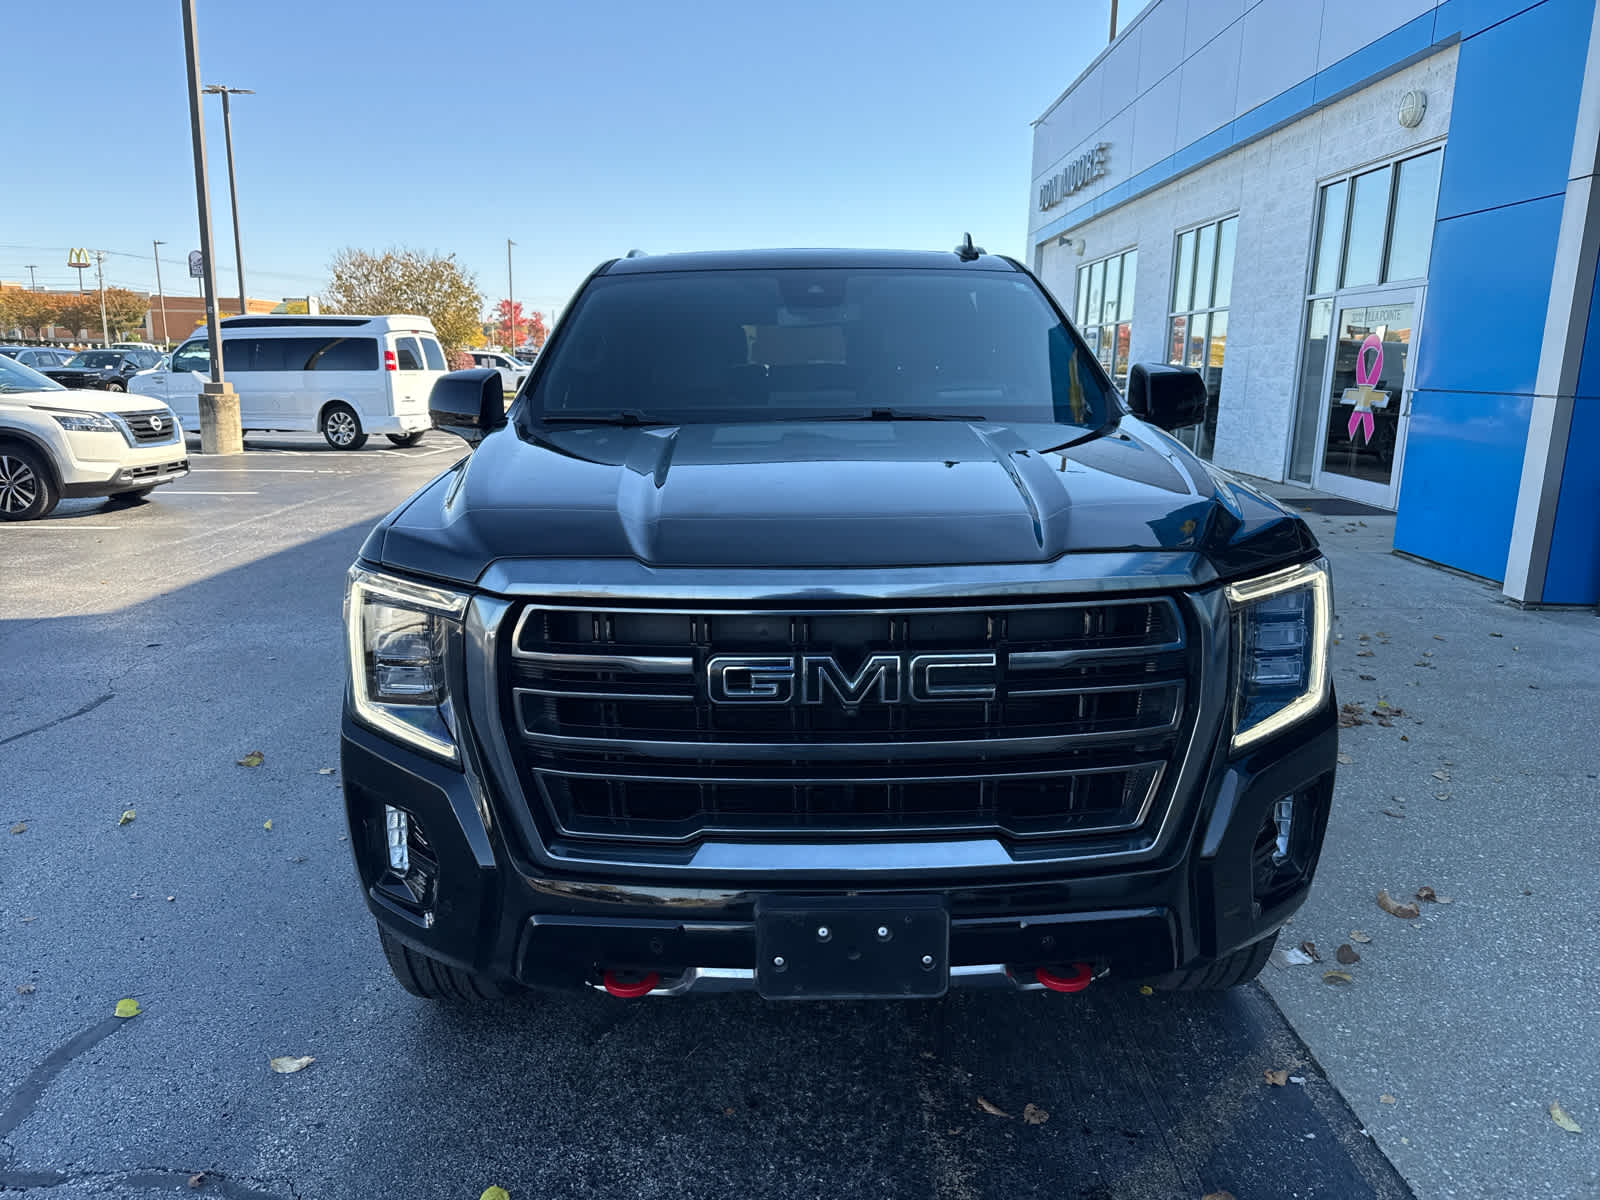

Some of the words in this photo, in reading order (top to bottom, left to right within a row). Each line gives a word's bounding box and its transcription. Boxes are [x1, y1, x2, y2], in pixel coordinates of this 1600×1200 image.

[1040, 174, 1062, 210] DON
[1063, 142, 1111, 197] MOORE
[706, 653, 997, 703] GMC
